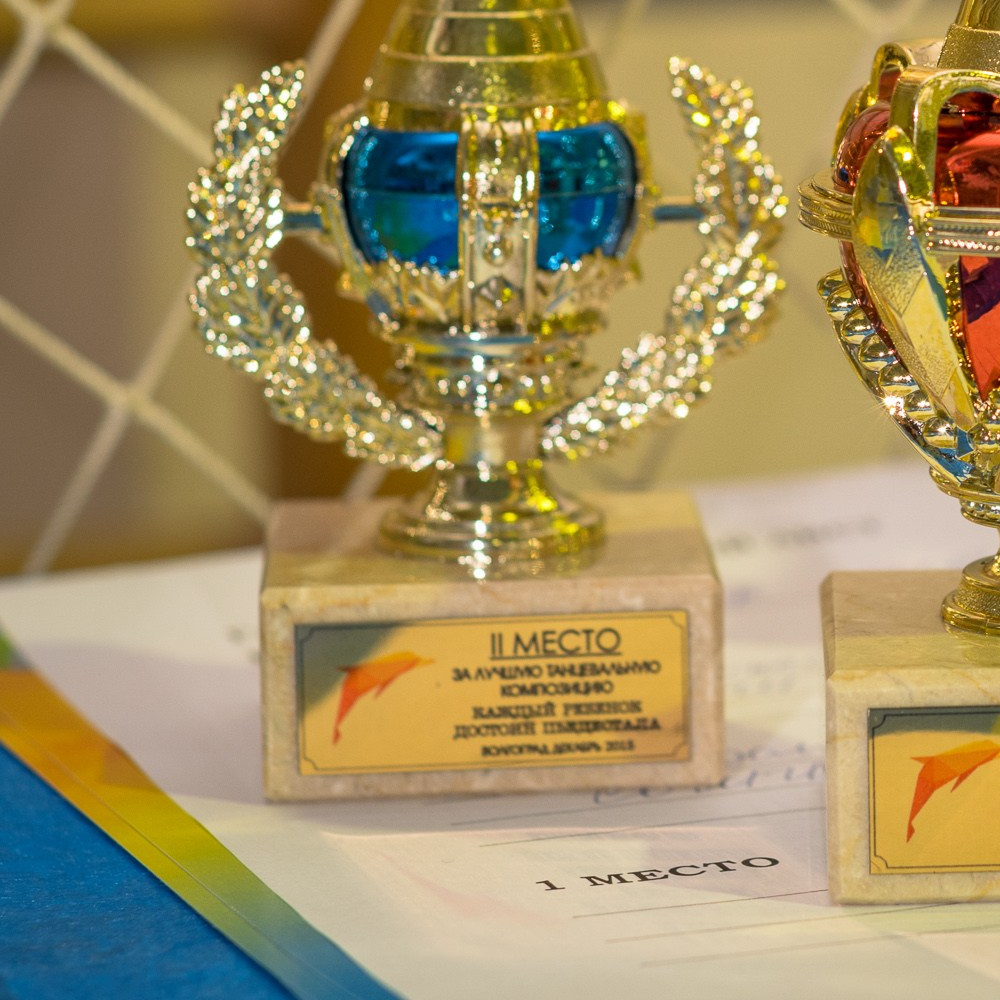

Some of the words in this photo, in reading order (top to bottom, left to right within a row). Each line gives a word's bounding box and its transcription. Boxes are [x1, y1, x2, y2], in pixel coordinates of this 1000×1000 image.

[514, 628, 621, 655] МЕСТО
[452, 667, 471, 681] ЗА
[536, 879, 565, 891] 1
[580, 857, 779, 887] МЕСТО
